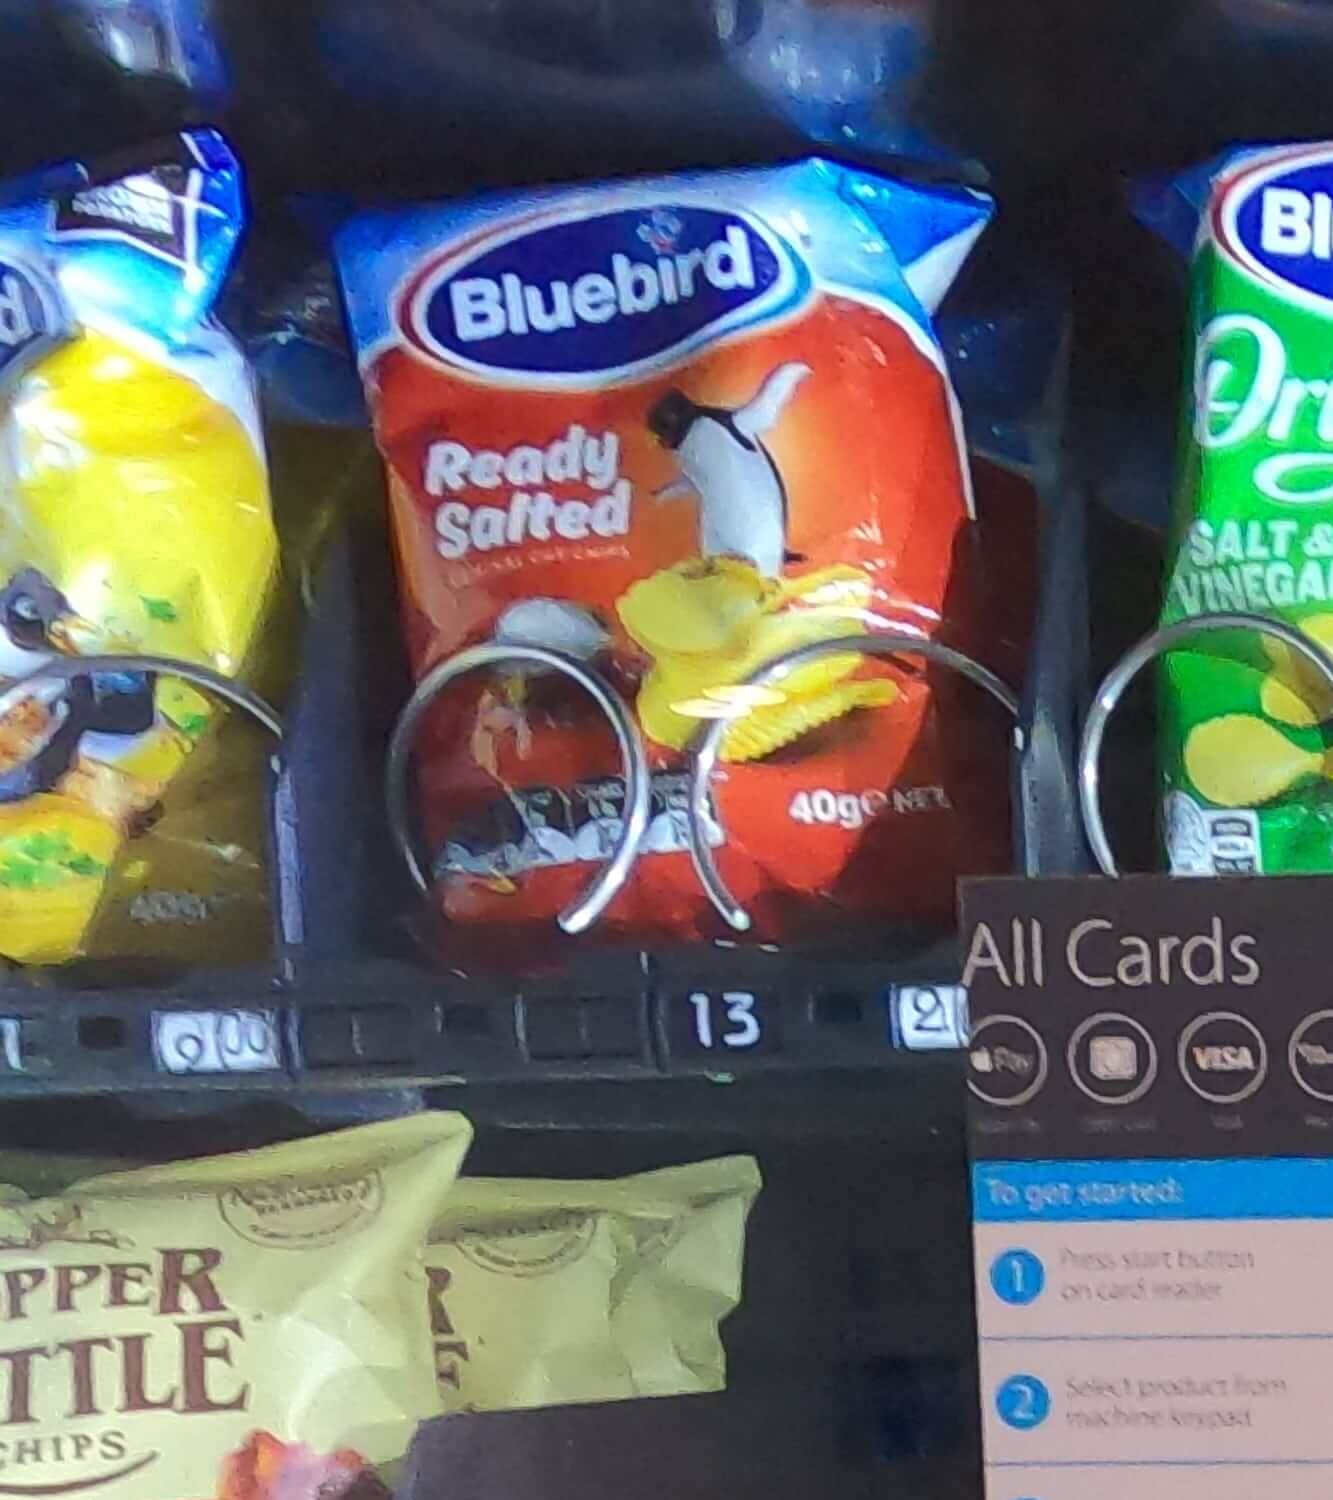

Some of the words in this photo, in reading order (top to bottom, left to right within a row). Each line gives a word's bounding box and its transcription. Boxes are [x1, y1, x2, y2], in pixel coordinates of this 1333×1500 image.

[448, 226, 756, 342] Bluebird
[424, 425, 619, 497] Ready
[436, 478, 632, 560] Salted
[1189, 518, 1298, 567] SALT
[960, 917, 1043, 988] All
[1066, 916, 1260, 988] Cards
[688, 992, 761, 1049] 13
[985, 1178, 1019, 1205] To
[1025, 1181, 1073, 1212] get
[1011, 1259, 1025, 1293] 1
[1012, 1385, 1035, 1420] 2
